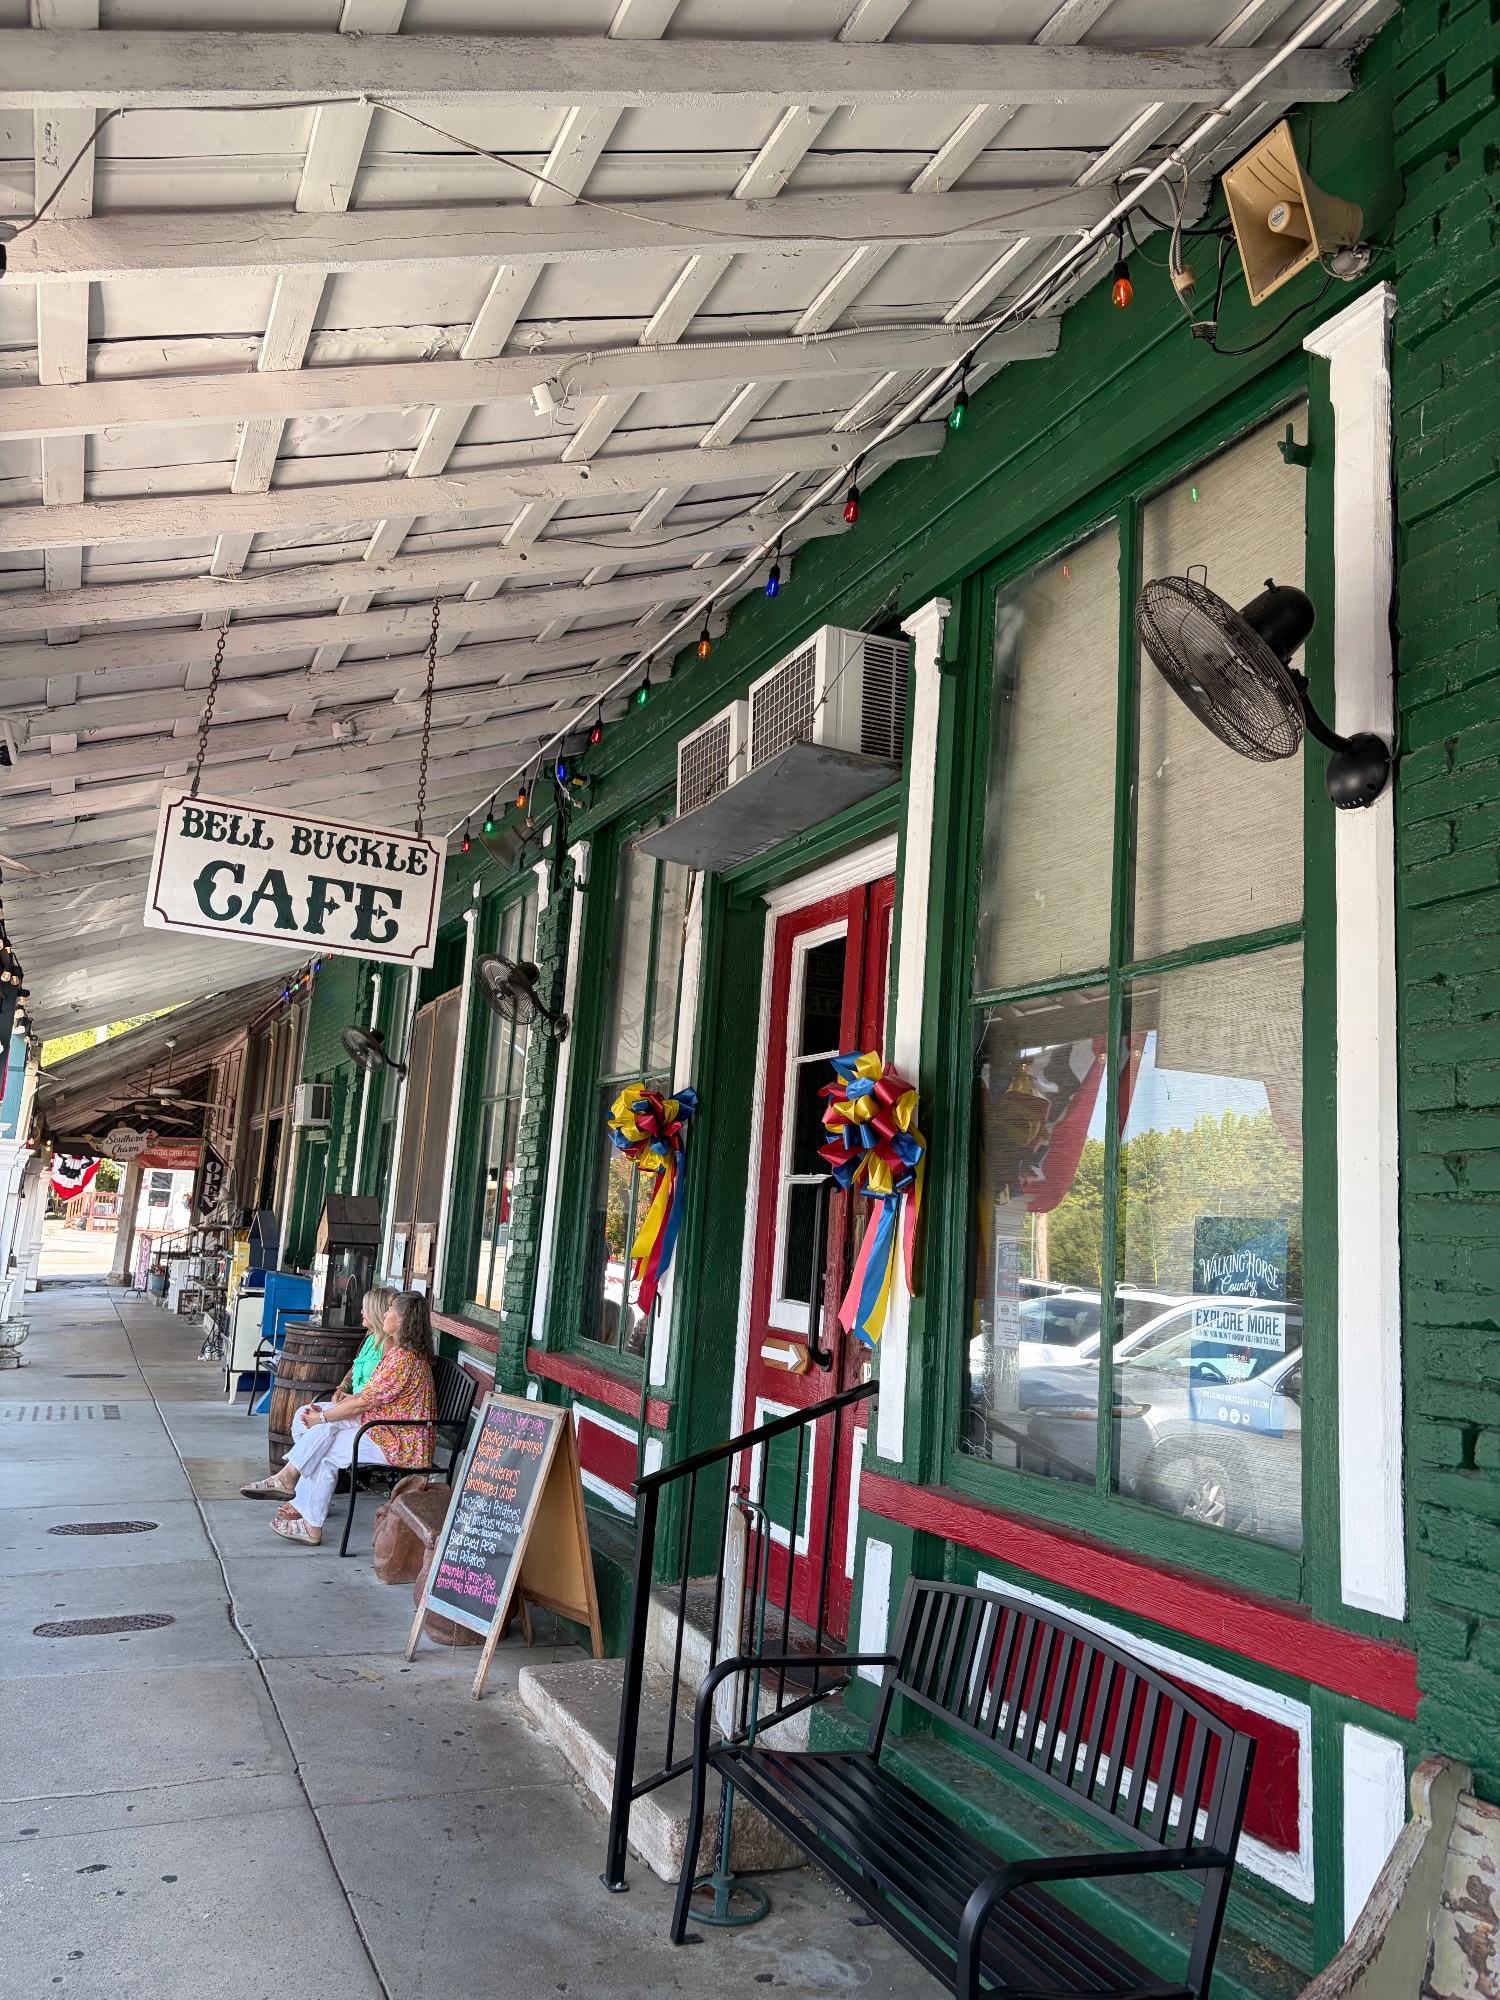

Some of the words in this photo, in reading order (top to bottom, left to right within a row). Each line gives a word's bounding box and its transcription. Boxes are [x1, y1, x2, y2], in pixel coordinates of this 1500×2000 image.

[179, 806, 274, 850] BELL
[290, 825, 429, 876] BUCKLE
[193, 859, 403, 944] CAFE
[106, 1133, 144, 1144] Southern
[111, 1143, 139, 1155] Charm
[169, 1149, 182, 1157] COFFEE
[200, 1161, 222, 1208] OPEN
[137, 1238, 149, 1285] OPEN
[1199, 1252, 1245, 1286] WALKING
[1244, 1249, 1280, 1290] HORSE
[1219, 1275, 1258, 1297] Country
[1195, 1308, 1244, 1332] EXPLORE
[513, 1413, 546, 1435] Specials
